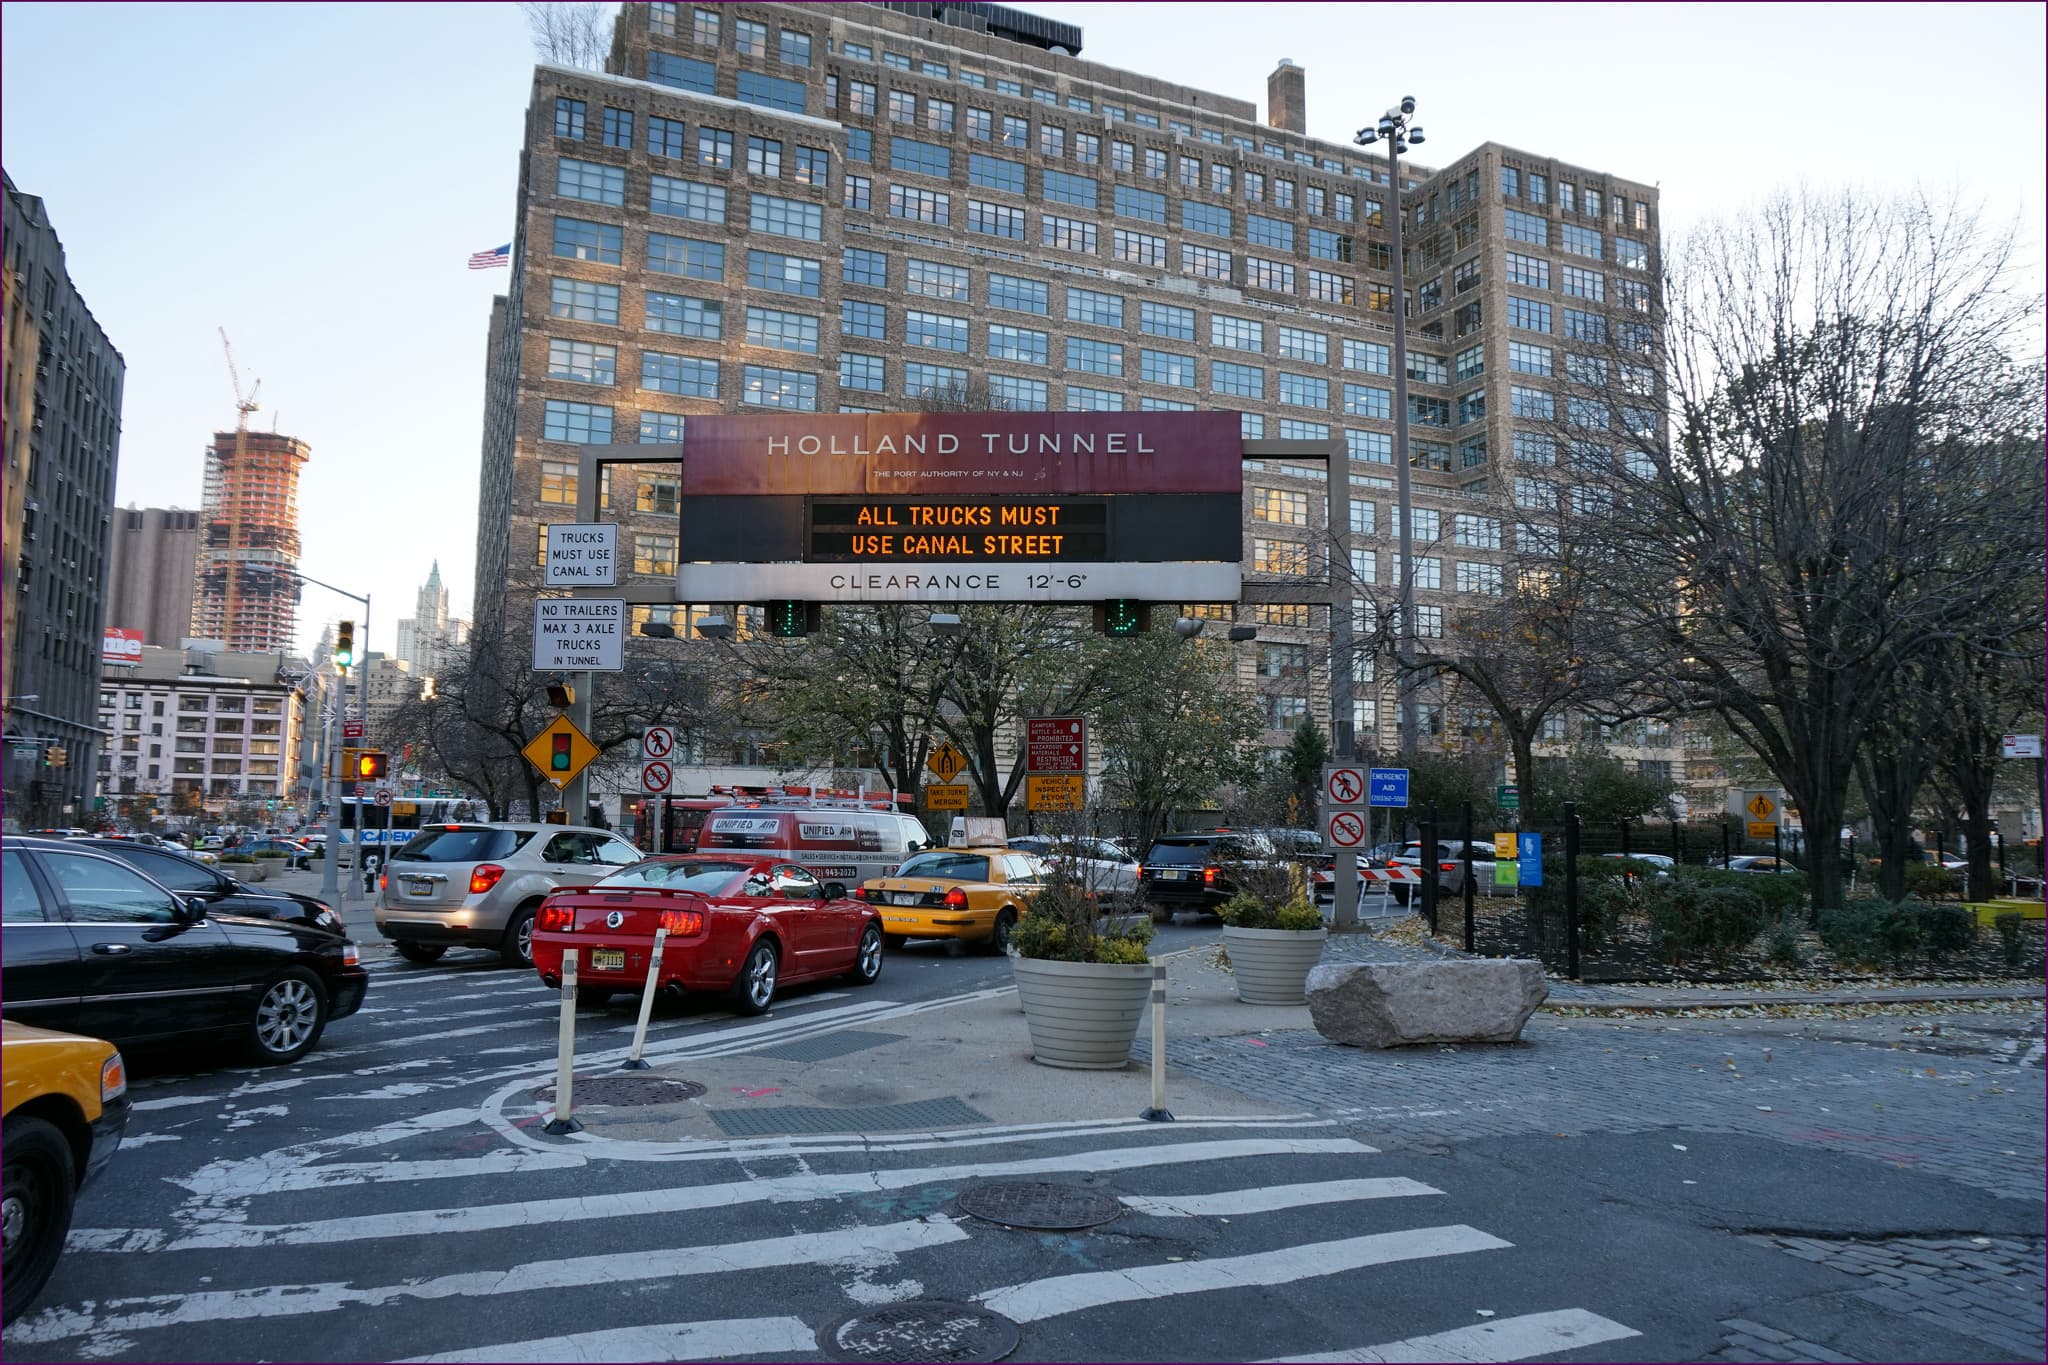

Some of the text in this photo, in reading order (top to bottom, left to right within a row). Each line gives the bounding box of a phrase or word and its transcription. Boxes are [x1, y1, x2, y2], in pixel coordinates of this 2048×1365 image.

[768, 433, 1155, 456] HOLLAND TUNNEL
[920, 470, 968, 478] AUTHORITY
[857, 506, 1060, 525] ALL TRUCKS MUST
[561, 533, 604, 543] TRUCKS
[852, 535, 1063, 554] USE CANAL STREET
[552, 550, 610, 560] MUST USE
[553, 566, 608, 576] CANAL ST
[830, 575, 1000, 589] CLEARANCE
[542, 605, 618, 615] NO TRAILERS
[543, 623, 615, 633] MAX 3 AXLE
[557, 639, 601, 650] TRUCKS
[553, 656, 601, 665] IN TUNNEL
[934, 798, 962, 806] MERGING
[715, 820, 778, 829] UNIFIED AIR
[803, 825, 835, 835] UNIFIED
[840, 826, 852, 835] AIR
